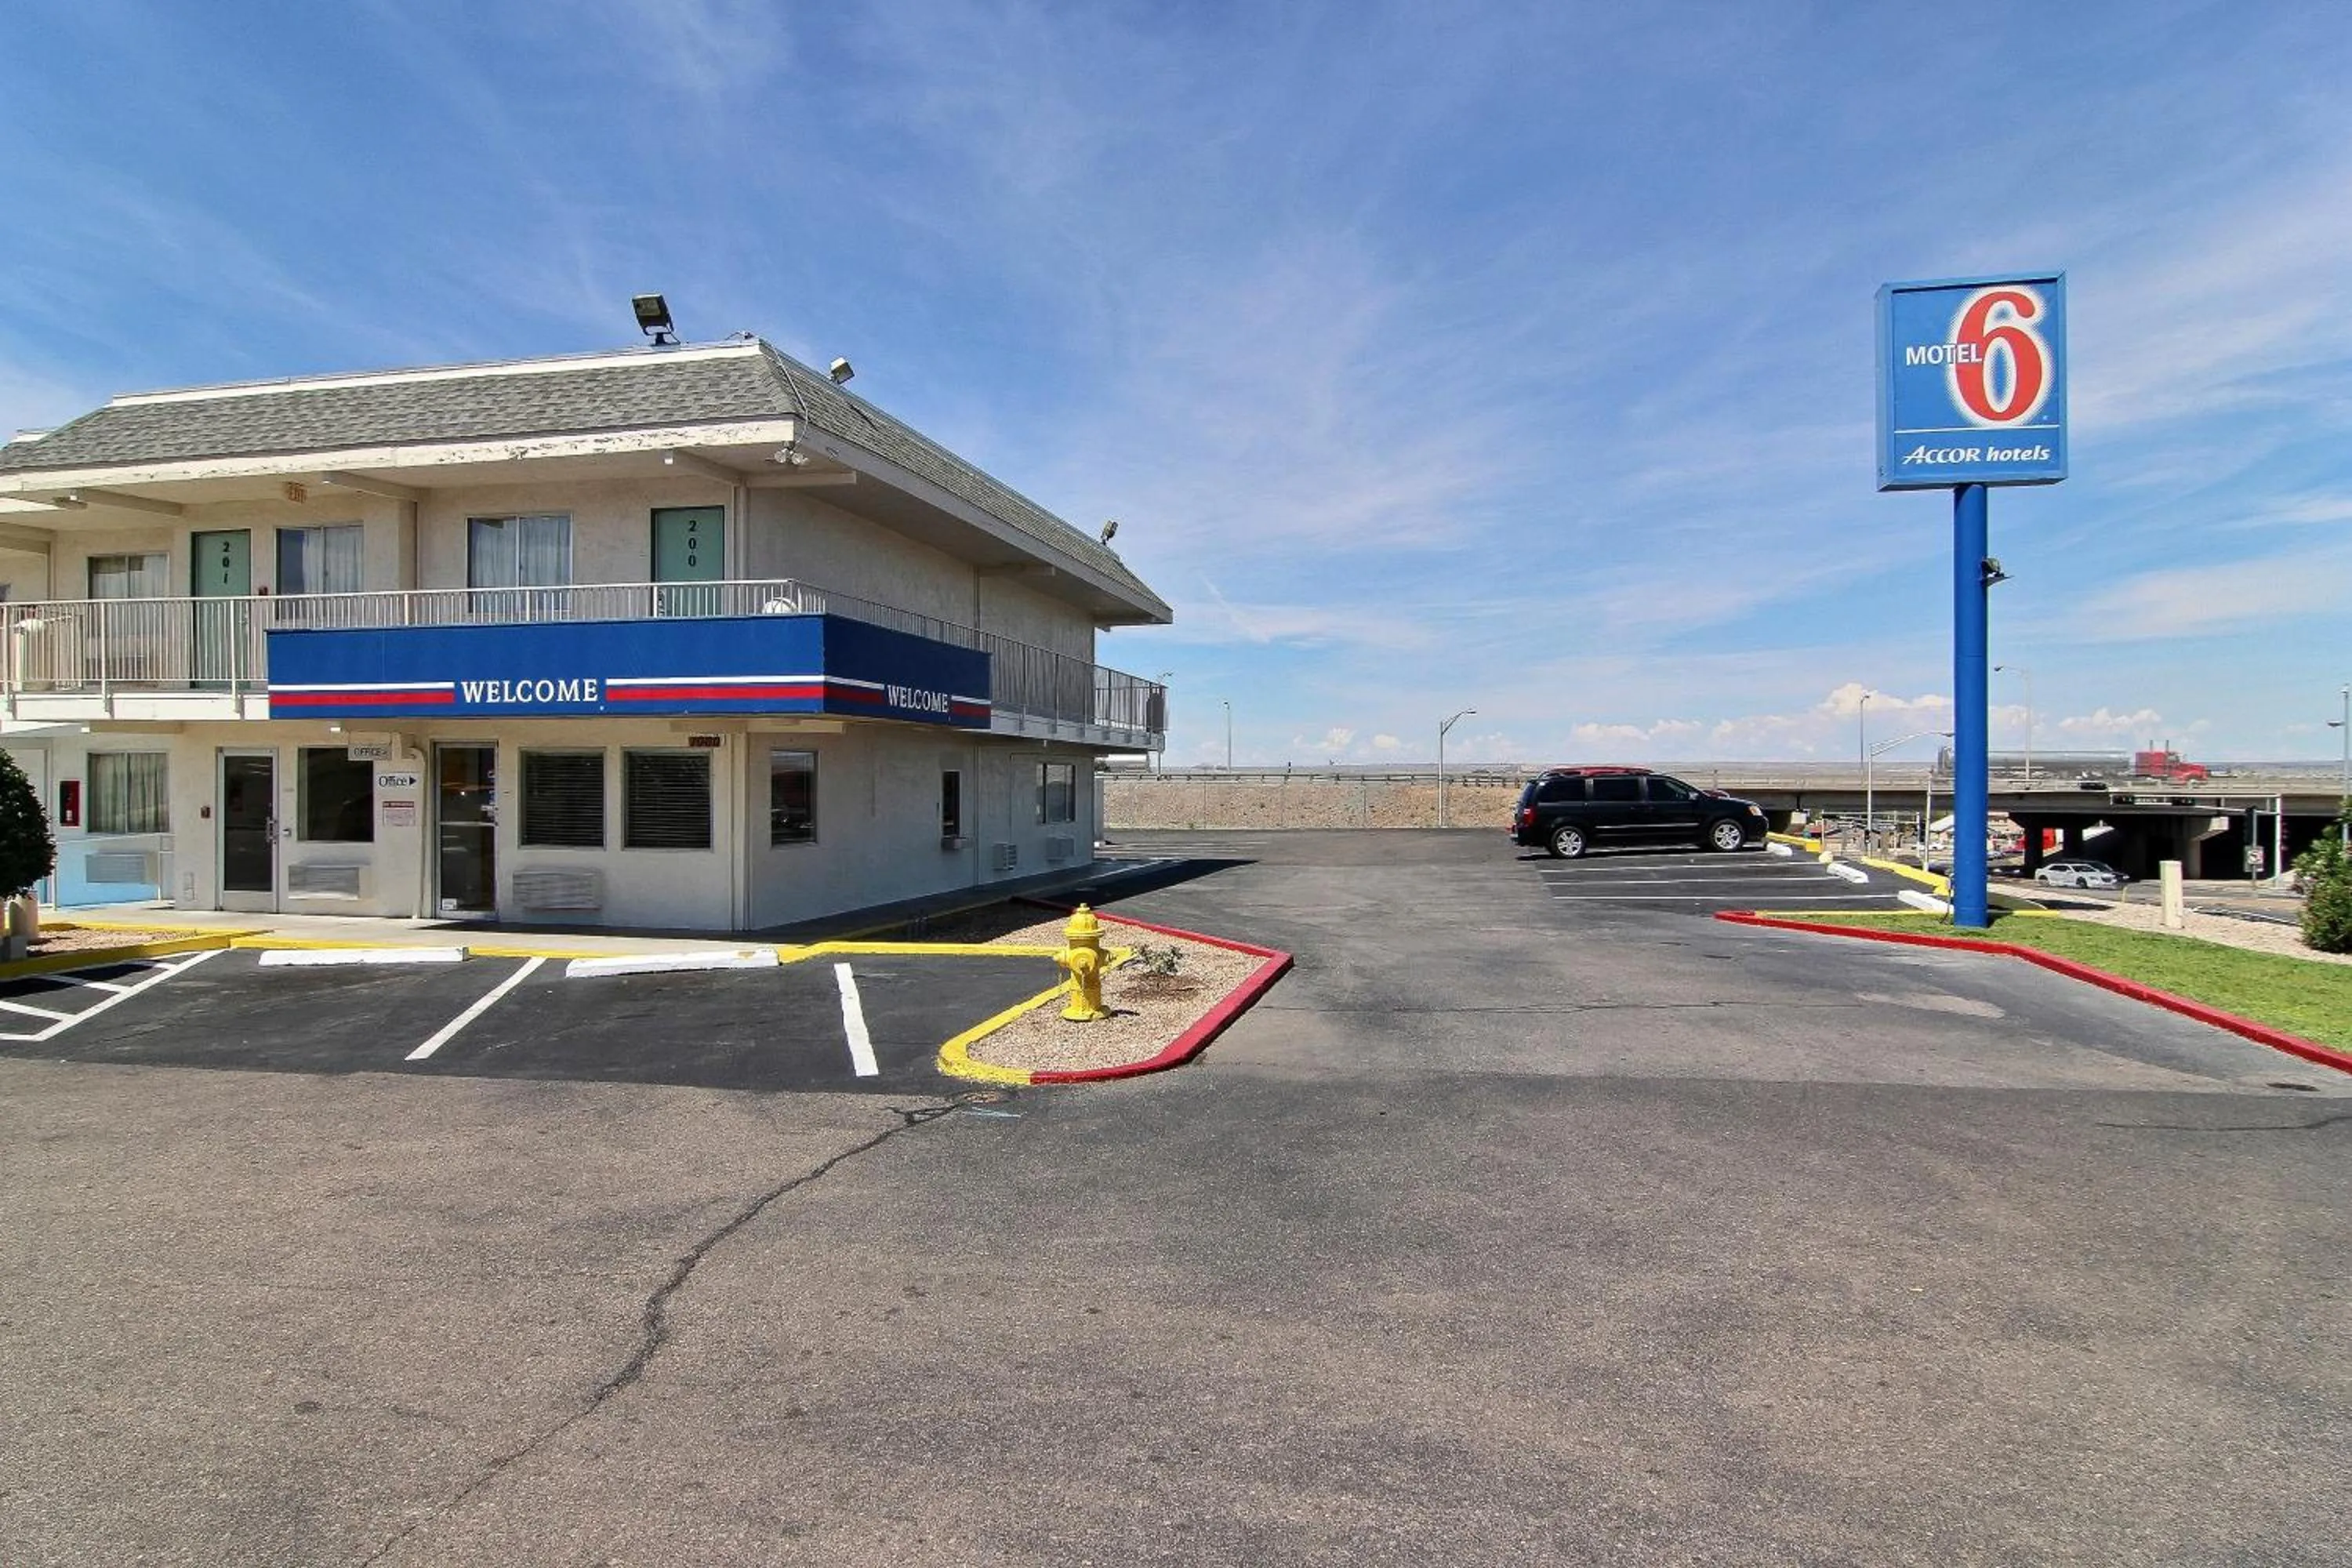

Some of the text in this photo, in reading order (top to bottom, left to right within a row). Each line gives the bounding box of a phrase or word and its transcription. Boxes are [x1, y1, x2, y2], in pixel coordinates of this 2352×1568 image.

[1905, 290, 2043, 422] MOTEL 6
[1902, 445, 2051, 465] ACCOR hotels
[688, 519, 697, 567] 200
[460, 678, 598, 703] WELCOME
[887, 684, 949, 713] WELCOME
[379, 775, 408, 787] Office
